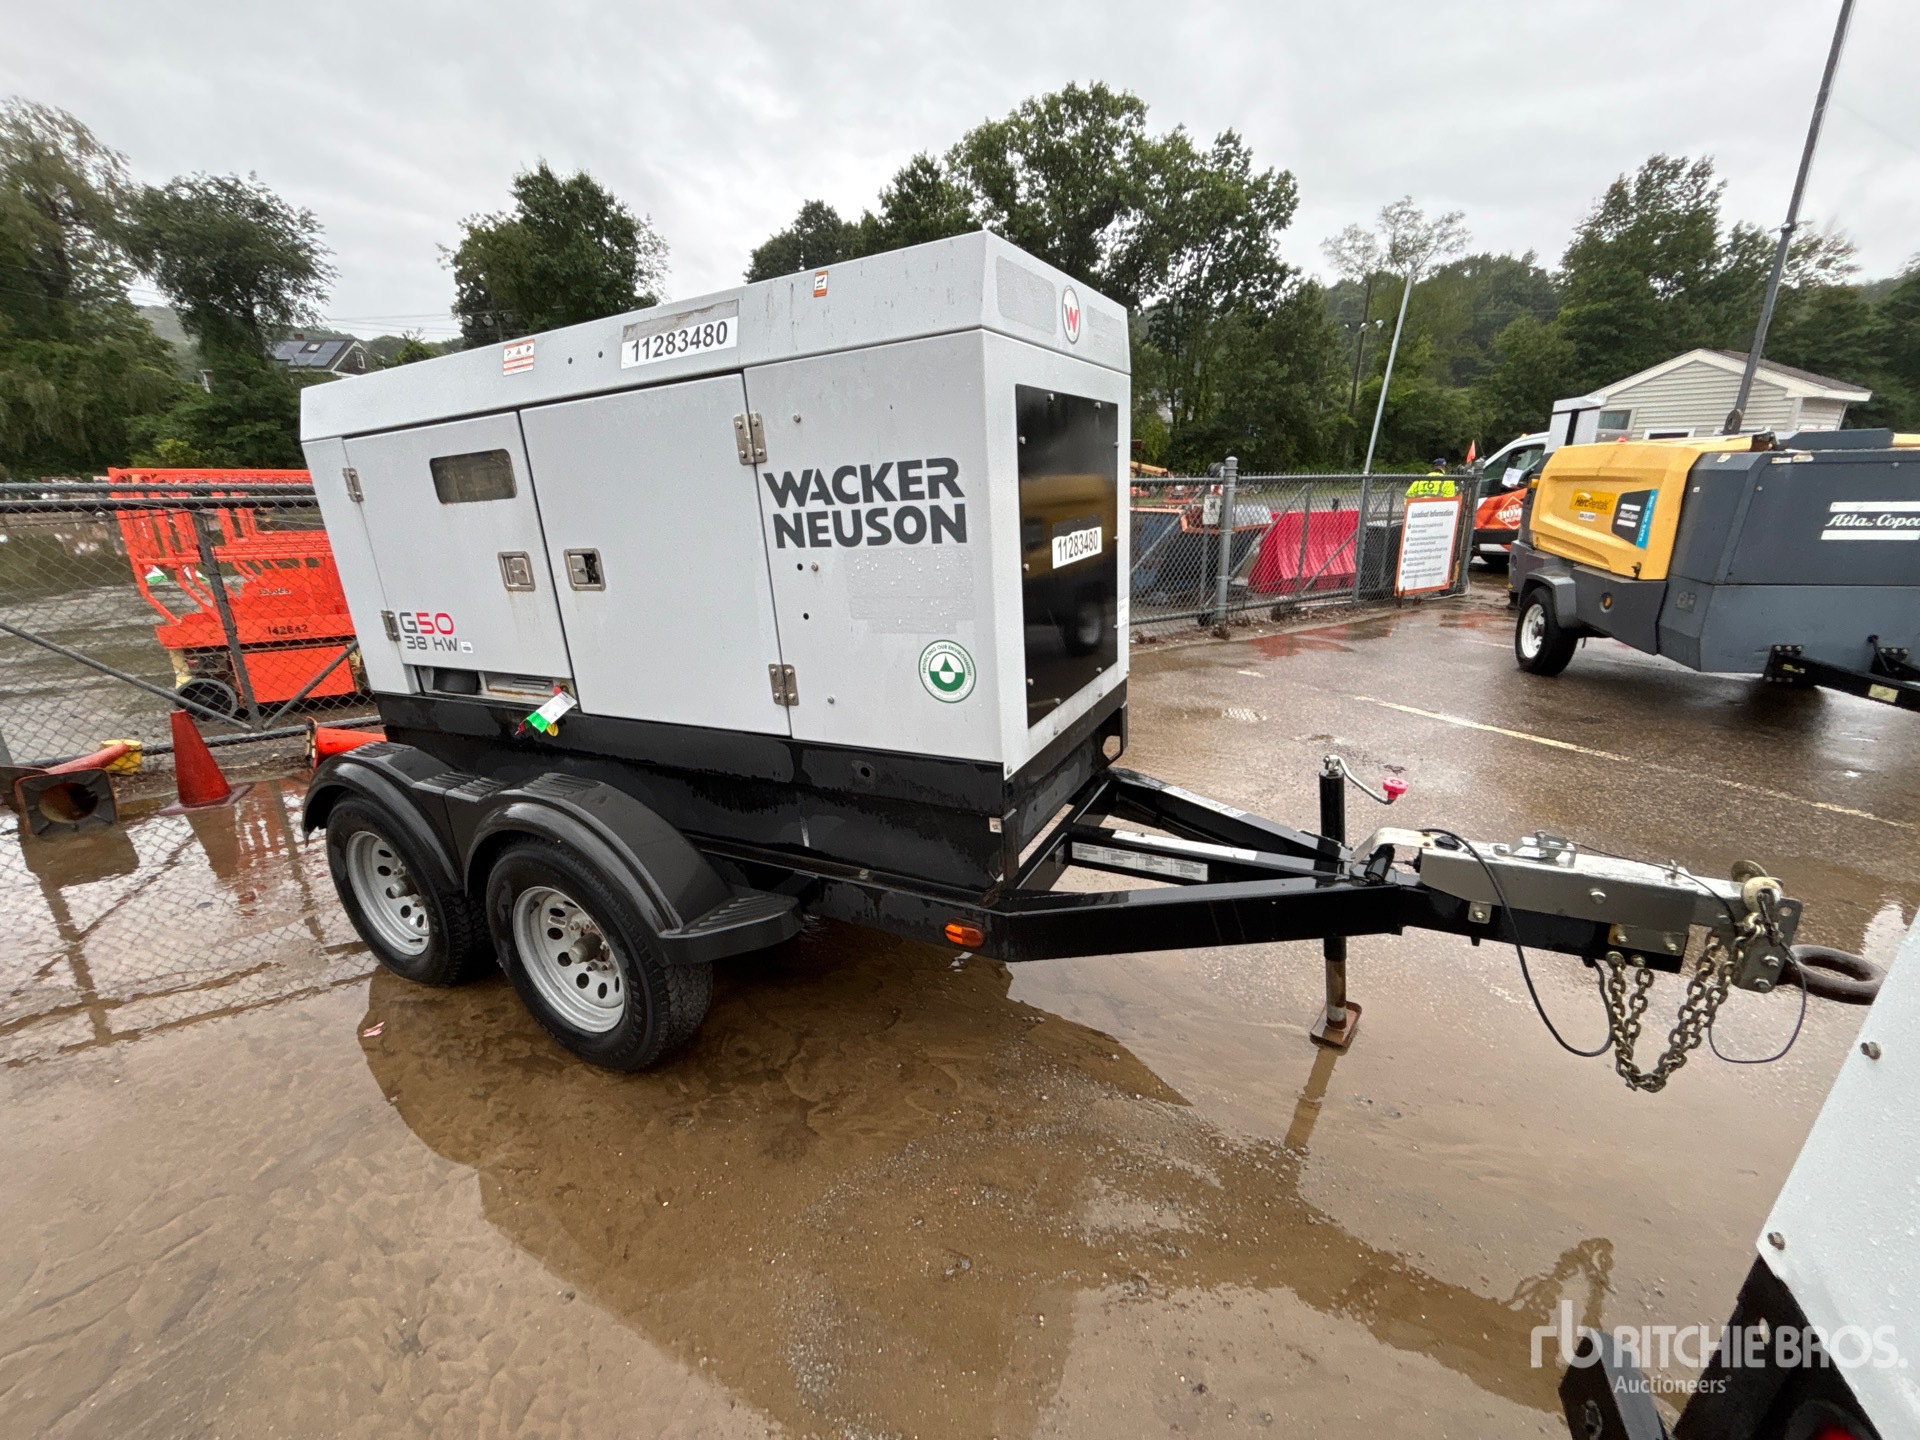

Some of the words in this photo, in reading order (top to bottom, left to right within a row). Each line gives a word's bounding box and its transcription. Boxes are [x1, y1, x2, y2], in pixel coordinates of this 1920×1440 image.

[631, 320, 728, 362] 11283480
[763, 457, 966, 508] WACKER
[772, 503, 968, 549] NEUSON
[1499, 508, 1523, 519] HOM
[1057, 529, 1098, 562] 11283480
[399, 611, 454, 635] G50
[404, 635, 428, 650] 38
